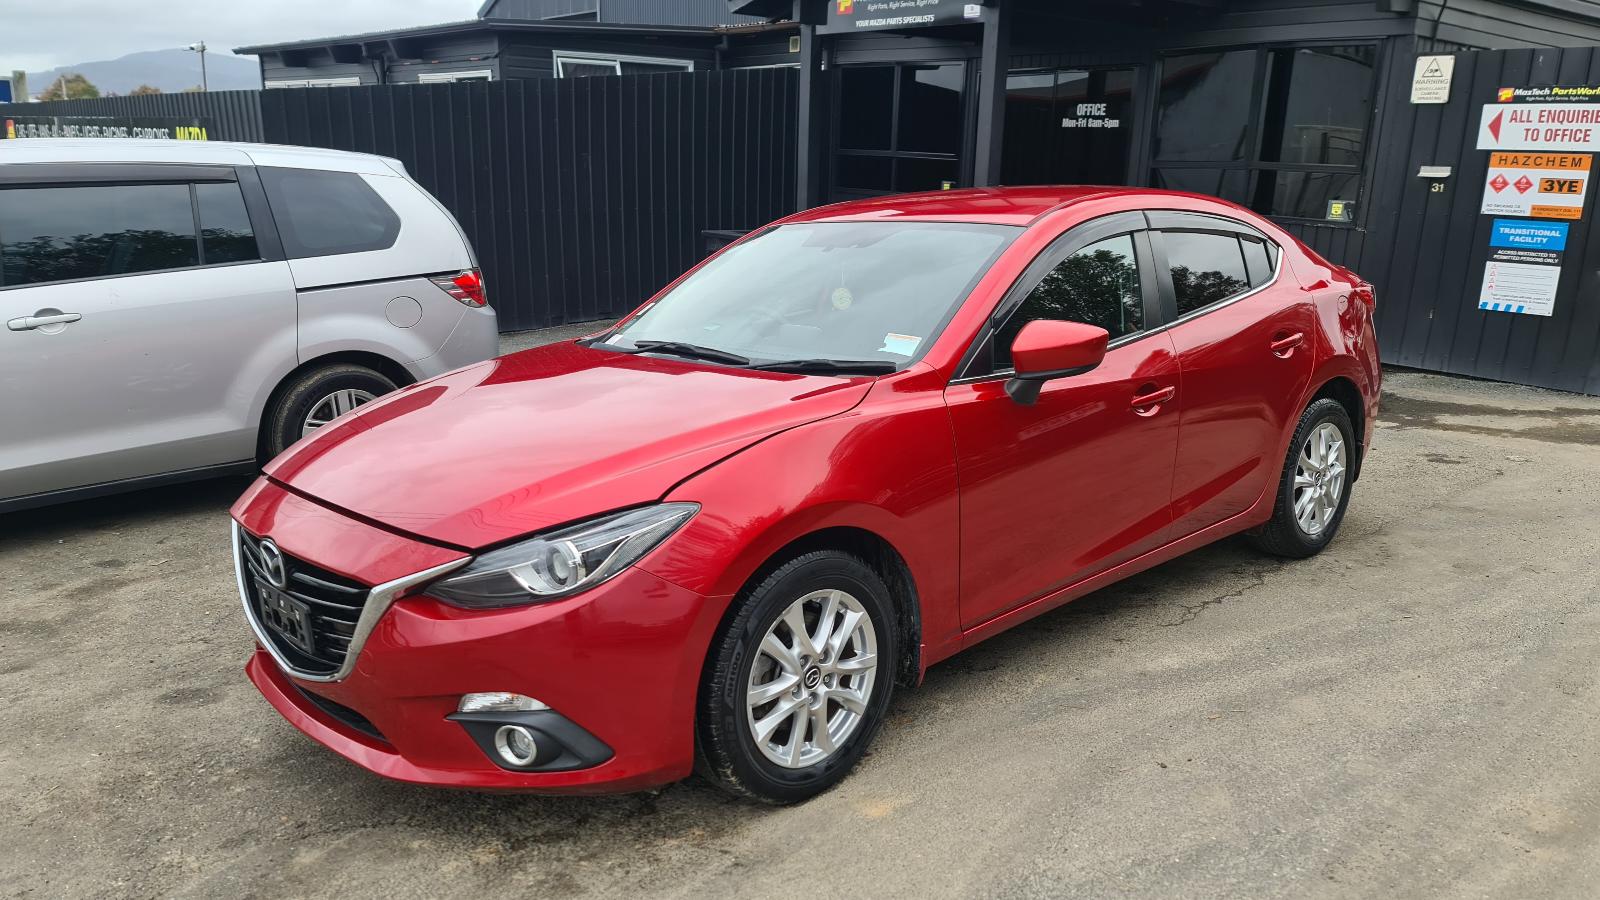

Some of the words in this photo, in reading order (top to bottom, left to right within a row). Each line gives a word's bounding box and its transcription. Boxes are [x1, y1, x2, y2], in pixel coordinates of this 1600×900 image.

[856, 19, 869, 27] YOUR
[869, 18, 886, 26] MAZDA
[887, 17, 902, 25] PARTS
[903, 14, 935, 24] SPECIALISTS
[1552, 87, 1600, 95] PartsWorl
[1076, 103, 1107, 116] OFFICE
[1062, 118, 1087, 128] Mon-Fri
[1088, 118, 1119, 128] 8am-5pm
[1509, 109, 1533, 123] ALL
[1538, 109, 1600, 125] ENQUIRIE
[176, 126, 208, 141] MAZDA
[1524, 128, 1540, 142] TO
[1544, 128, 1592, 142] OFFICE
[1498, 155, 1583, 168] HAZCHEM
[1431, 183, 1445, 193] 31
[1544, 179, 1579, 193] 3YE
[1499, 227, 1561, 237] TRANSITIONAL
[1509, 235, 1549, 244] FACILITY
